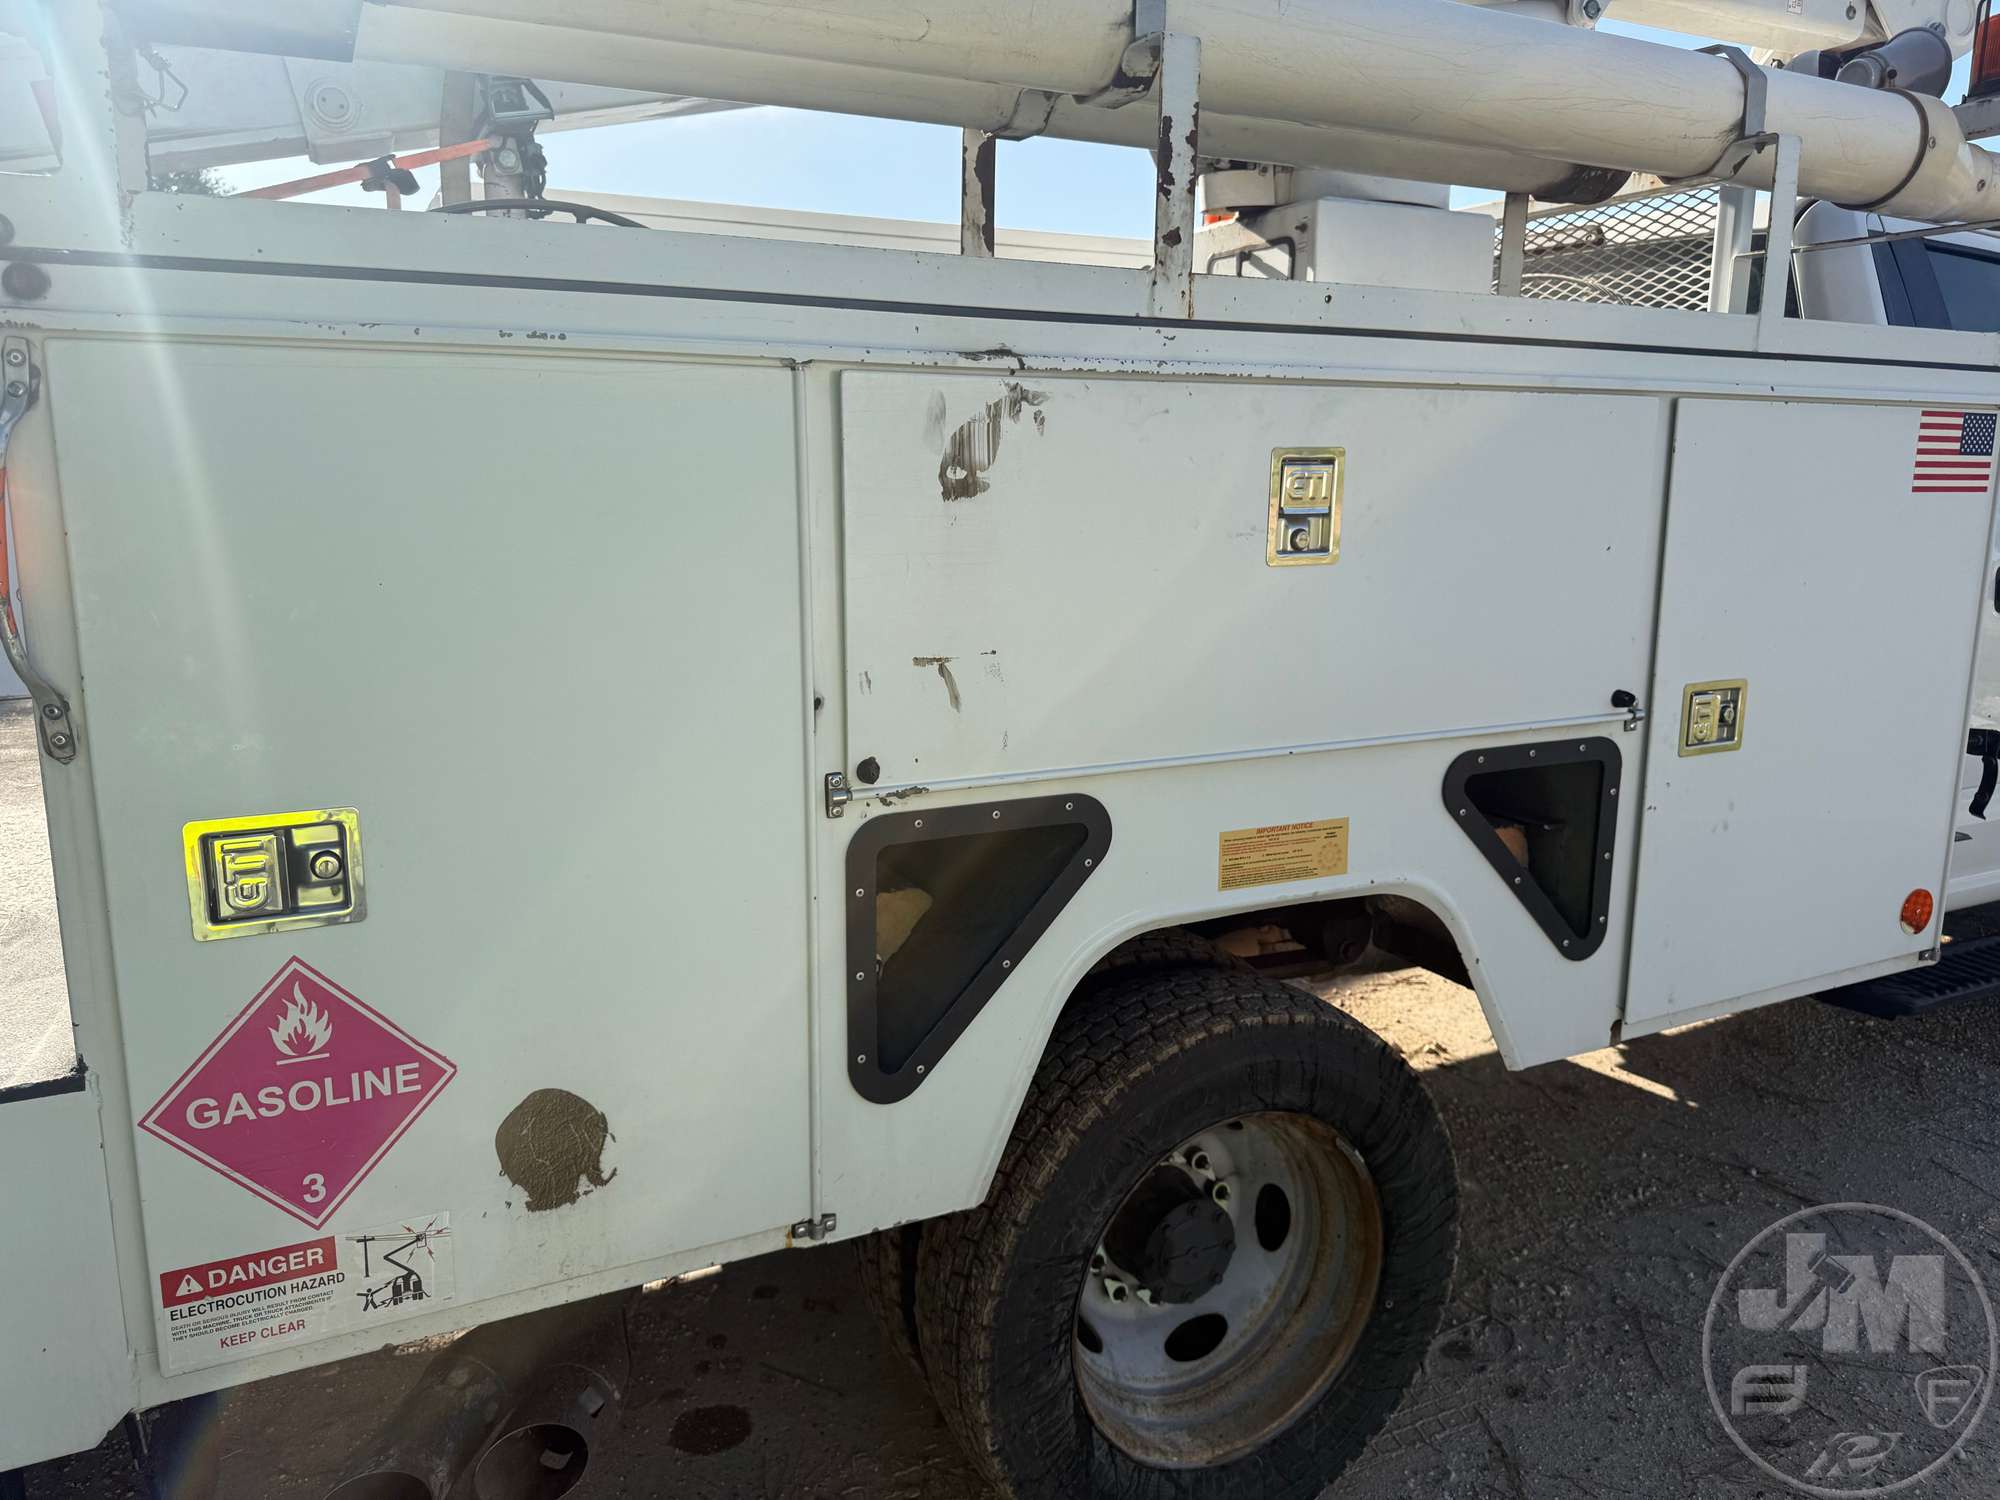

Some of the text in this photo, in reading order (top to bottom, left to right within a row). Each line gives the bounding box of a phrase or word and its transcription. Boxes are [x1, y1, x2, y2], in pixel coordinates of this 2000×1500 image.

[1256, 821, 1313, 834] IMPORTANT NOTICE
[185, 1062, 422, 1130] GASOLINE
[302, 1173, 327, 1203] 3
[207, 1247, 325, 1289] DANGER
[169, 1272, 345, 1322] ELECTROCUTION HAZARD
[170, 1322, 191, 1331] DEATH
[202, 1313, 229, 1324] SERIOUS
[229, 1308, 250, 1318] INJURY
[251, 1305, 266, 1313] WILL
[267, 1300, 288, 1309] RESULT
[289, 1295, 306, 1304] FROM
[307, 1289, 334, 1300] CONTACT
[171, 1328, 191, 1337] WITH
[233, 1313, 253, 1323] TRUCK
[263, 1306, 283, 1315] TRUCK
[284, 1296, 325, 1311] ATTACHMENTS
[172, 1334, 188, 1342] THEY
[188, 1328, 214, 1338] SHOULD
[214, 1322, 240, 1332] BECOME
[241, 1312, 283, 1326] ELECTRICALLY
[219, 1318, 306, 1349] KEEP CLEAR
